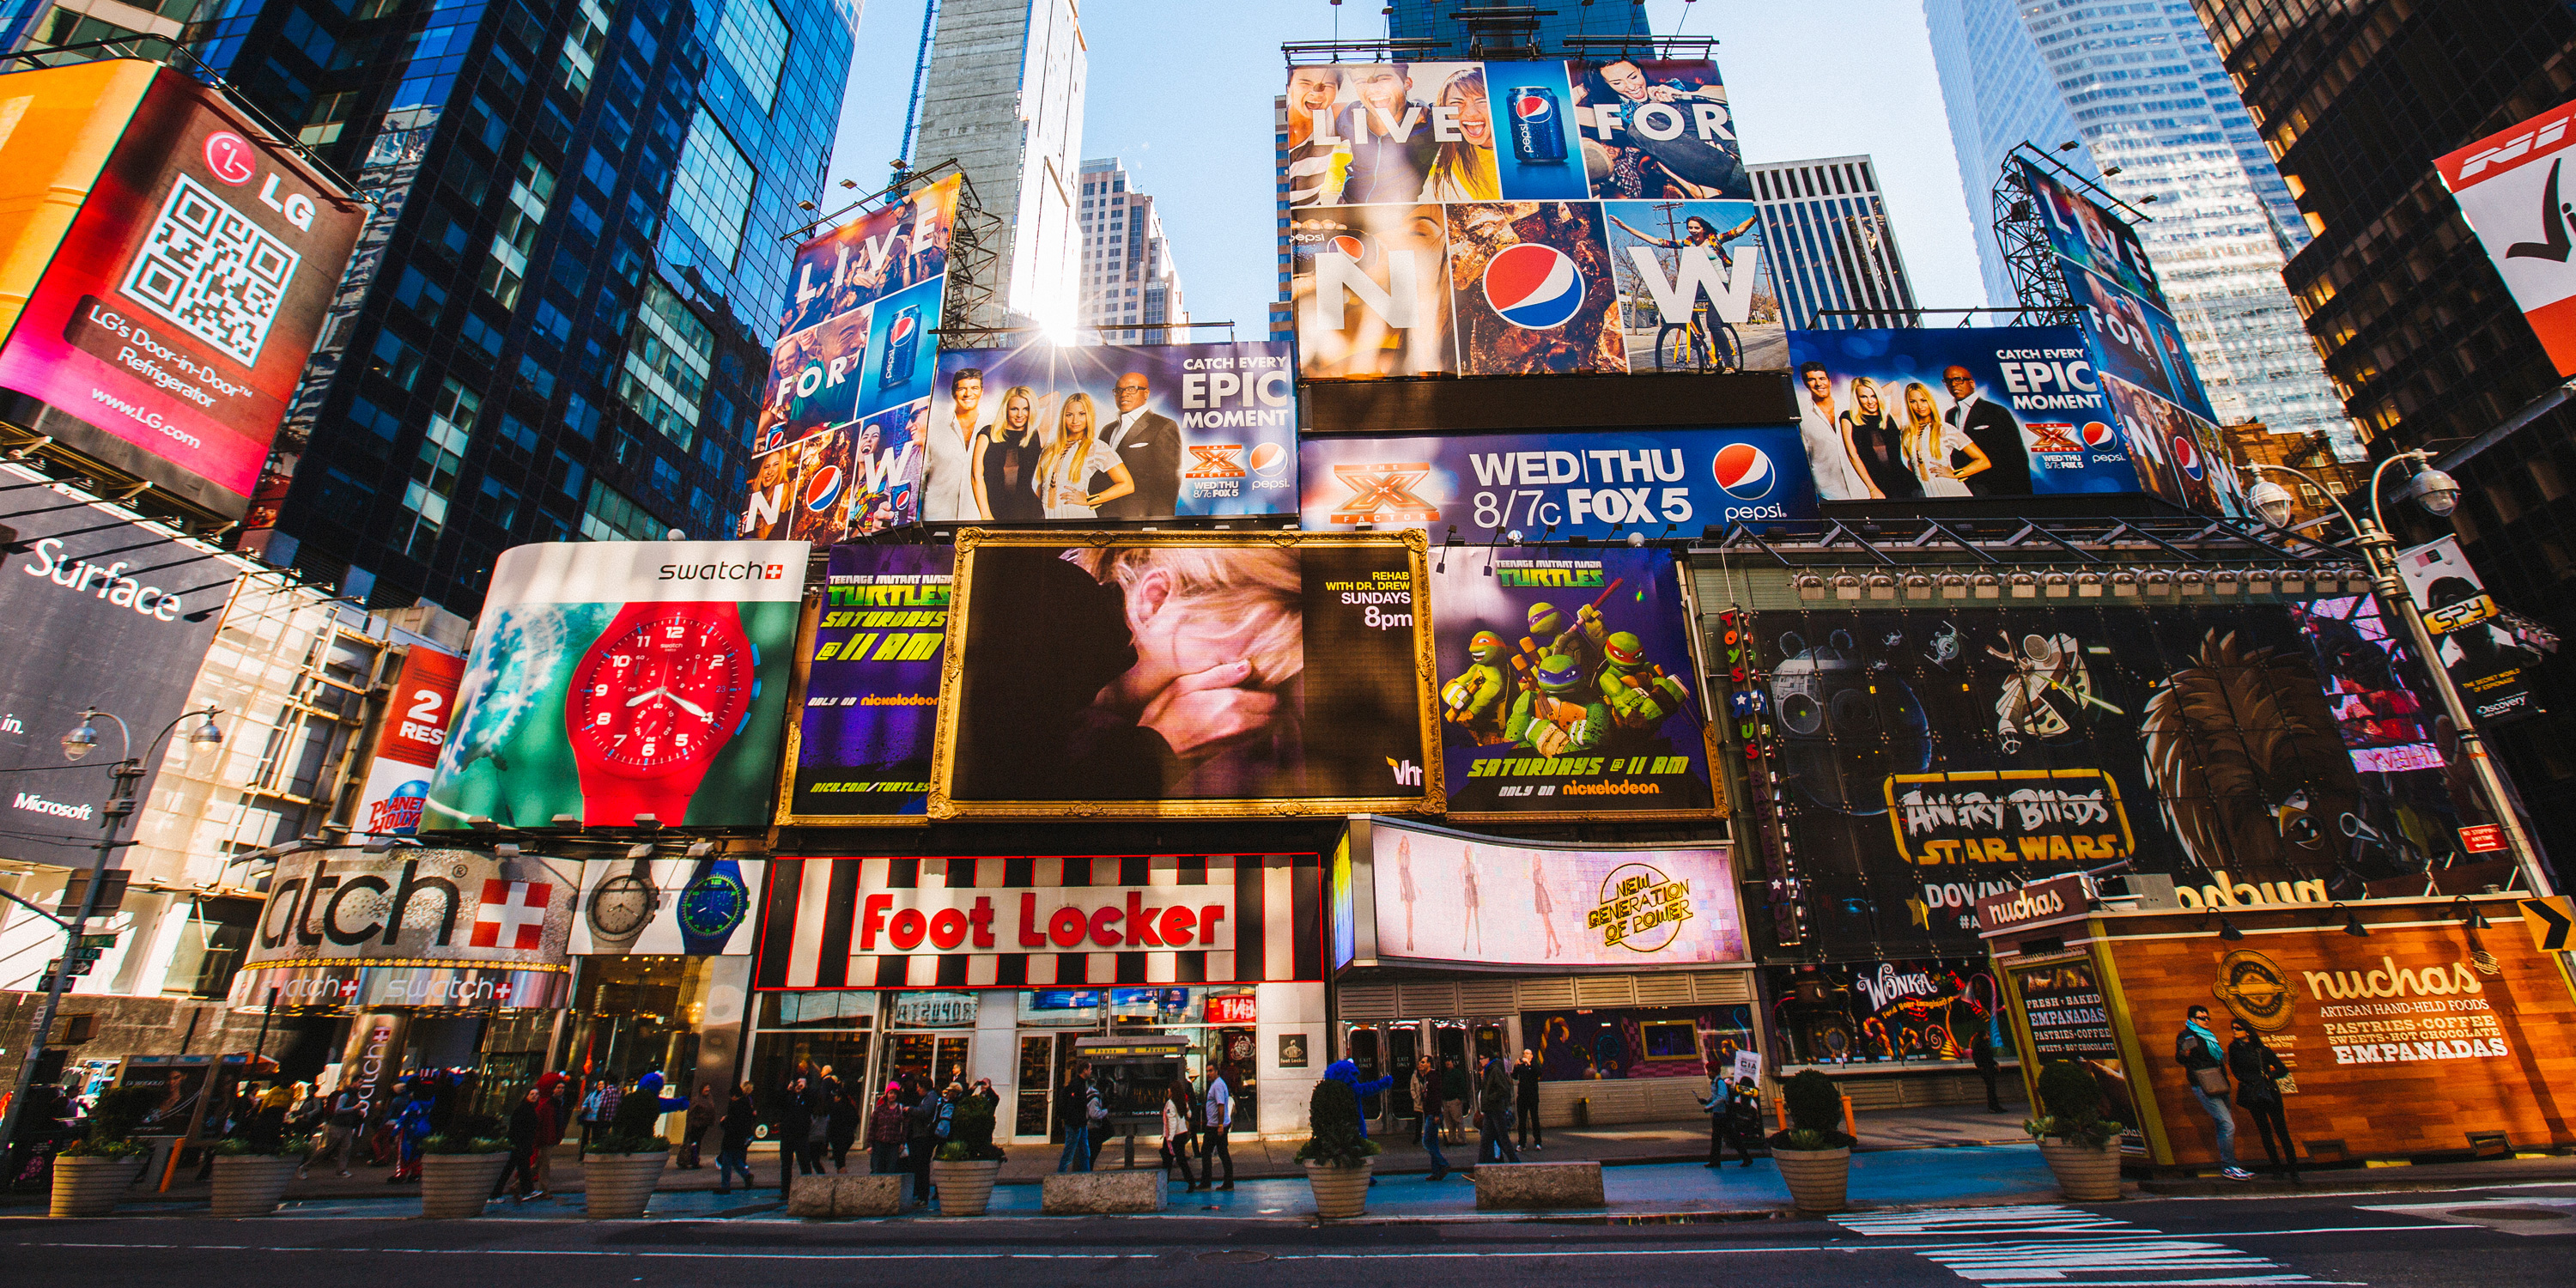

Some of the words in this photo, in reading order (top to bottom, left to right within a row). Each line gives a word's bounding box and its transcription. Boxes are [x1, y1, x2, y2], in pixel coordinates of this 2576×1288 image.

[1312, 106, 1462, 145] LIVE
[1593, 103, 1736, 141] FOR
[1522, 123, 1531, 153] pepsi
[258, 172, 317, 232] LG
[2042, 188, 2152, 283] LIVE
[796, 207, 939, 305] LIVE
[88, 304, 131, 339] LG's
[2087, 303, 2150, 355] FOR
[1183, 358, 1234, 370] CATCH
[1239, 356, 1287, 368] EVERY
[1996, 349, 2041, 359] CATCH
[2043, 349, 2084, 358] EVERY
[885, 349, 894, 380] pepsi
[117, 346, 216, 408] Refrigerator
[775, 355, 848, 408] FOR
[1999, 361, 2098, 392] EPIC
[1182, 370, 1287, 409] EPIC
[2012, 394, 2102, 410] MOMENT
[91, 387, 200, 449] www.LG.com
[1182, 410, 1288, 428] MOMENT
[2093, 453, 2123, 463] pepsi
[1194, 489, 1212, 498] 8/7c
[1252, 478, 1287, 489] pepsi
[1344, 513, 1426, 522] FACTOR
[1473, 489, 1562, 529] 8/7c
[1567, 489, 1652, 525] FOX
[1661, 487, 1693, 522] 5
[1725, 502, 1782, 522] pepsi
[658, 562, 764, 580] swatch
[1495, 560, 1534, 568] TEENAGE
[1536, 560, 1572, 568] MUTANT
[1574, 560, 1602, 568] NINJA
[24, 538, 182, 622] Surface
[829, 574, 874, 585] TEENAGE
[875, 574, 920, 585] MUTANT
[1326, 582, 1354, 591] WITH
[1356, 582, 1375, 591] DR.
[1377, 581, 1410, 591] DREW
[1372, 572, 1410, 580] REHAB
[1497, 568, 1605, 587] TURTLES
[827, 585, 953, 607] TURTLES
[1341, 592, 1411, 605] SUNDAYS
[820, 611, 948, 628] SATURDAYS
[1364, 606, 1413, 630] 8pm
[2433, 598, 2488, 630] SPY
[637, 636, 650, 647] 11
[665, 626, 684, 638] 12
[700, 635, 707, 647] 1
[871, 632, 945, 661] AM
[612, 655, 630, 667] 10
[711, 655, 725, 666] 2
[595, 684, 608, 696] 9
[407, 690, 442, 724] 2
[2476, 696, 2526, 715] Discovery
[0, 714, 24, 735] in.
[596, 713, 611, 725] 8
[700, 712, 714, 724] 4
[399, 720, 447, 745] RES
[613, 734, 627, 747] 7
[675, 734, 689, 746] 5
[641, 744, 655, 756] 6
[1467, 756, 1604, 777] SATURDAYS
[1609, 757, 1625, 772] @
[1649, 756, 1690, 775] AM
[1563, 779, 1660, 797] nickelodeon
[13, 792, 94, 821] Microsoft
[369, 796, 426, 817] PLANET
[1900, 790, 2004, 837] ANGRY
[2008, 788, 2109, 831] BIRDS
[1918, 836, 2018, 866] STAR
[1616, 872, 1650, 897] NEW
[1924, 880, 2018, 908] DOWN
[1589, 878, 1690, 929] GENERATION
[1987, 889, 2066, 925] nuchas
[860, 893, 995, 951] Foot
[1018, 890, 1224, 946] Locker
[1604, 920, 1630, 941] OF
[1632, 899, 1694, 934] POWER
[387, 977, 494, 999] swatch
[1856, 963, 1938, 1012] WONKA
[2302, 956, 2482, 1000] nuchas
[2026, 998, 2058, 1009] FRESH
[2065, 994, 2101, 1005] BAKED
[2320, 1004, 2372, 1018] ARTISAN
[2374, 1000, 2445, 1015] HAND-HELD
[2447, 999, 2490, 1012] FOODS
[2029, 1007, 2106, 1026] EMPANADAS
[2324, 1019, 2415, 1035] PASTRIES
[2422, 1015, 2496, 1029] COFFEE
[2033, 1030, 2074, 1041] PASTRIES
[2077, 1029, 2111, 1038] COFFEE
[2329, 1034, 2385, 1045] SWEETS
[2390, 1032, 2418, 1042] HOT
[2420, 1028, 2500, 1040] CHOCOLATE
[2331, 1037, 2509, 1065] EMPANADAS
[1741, 1060, 1757, 1070] CIA
